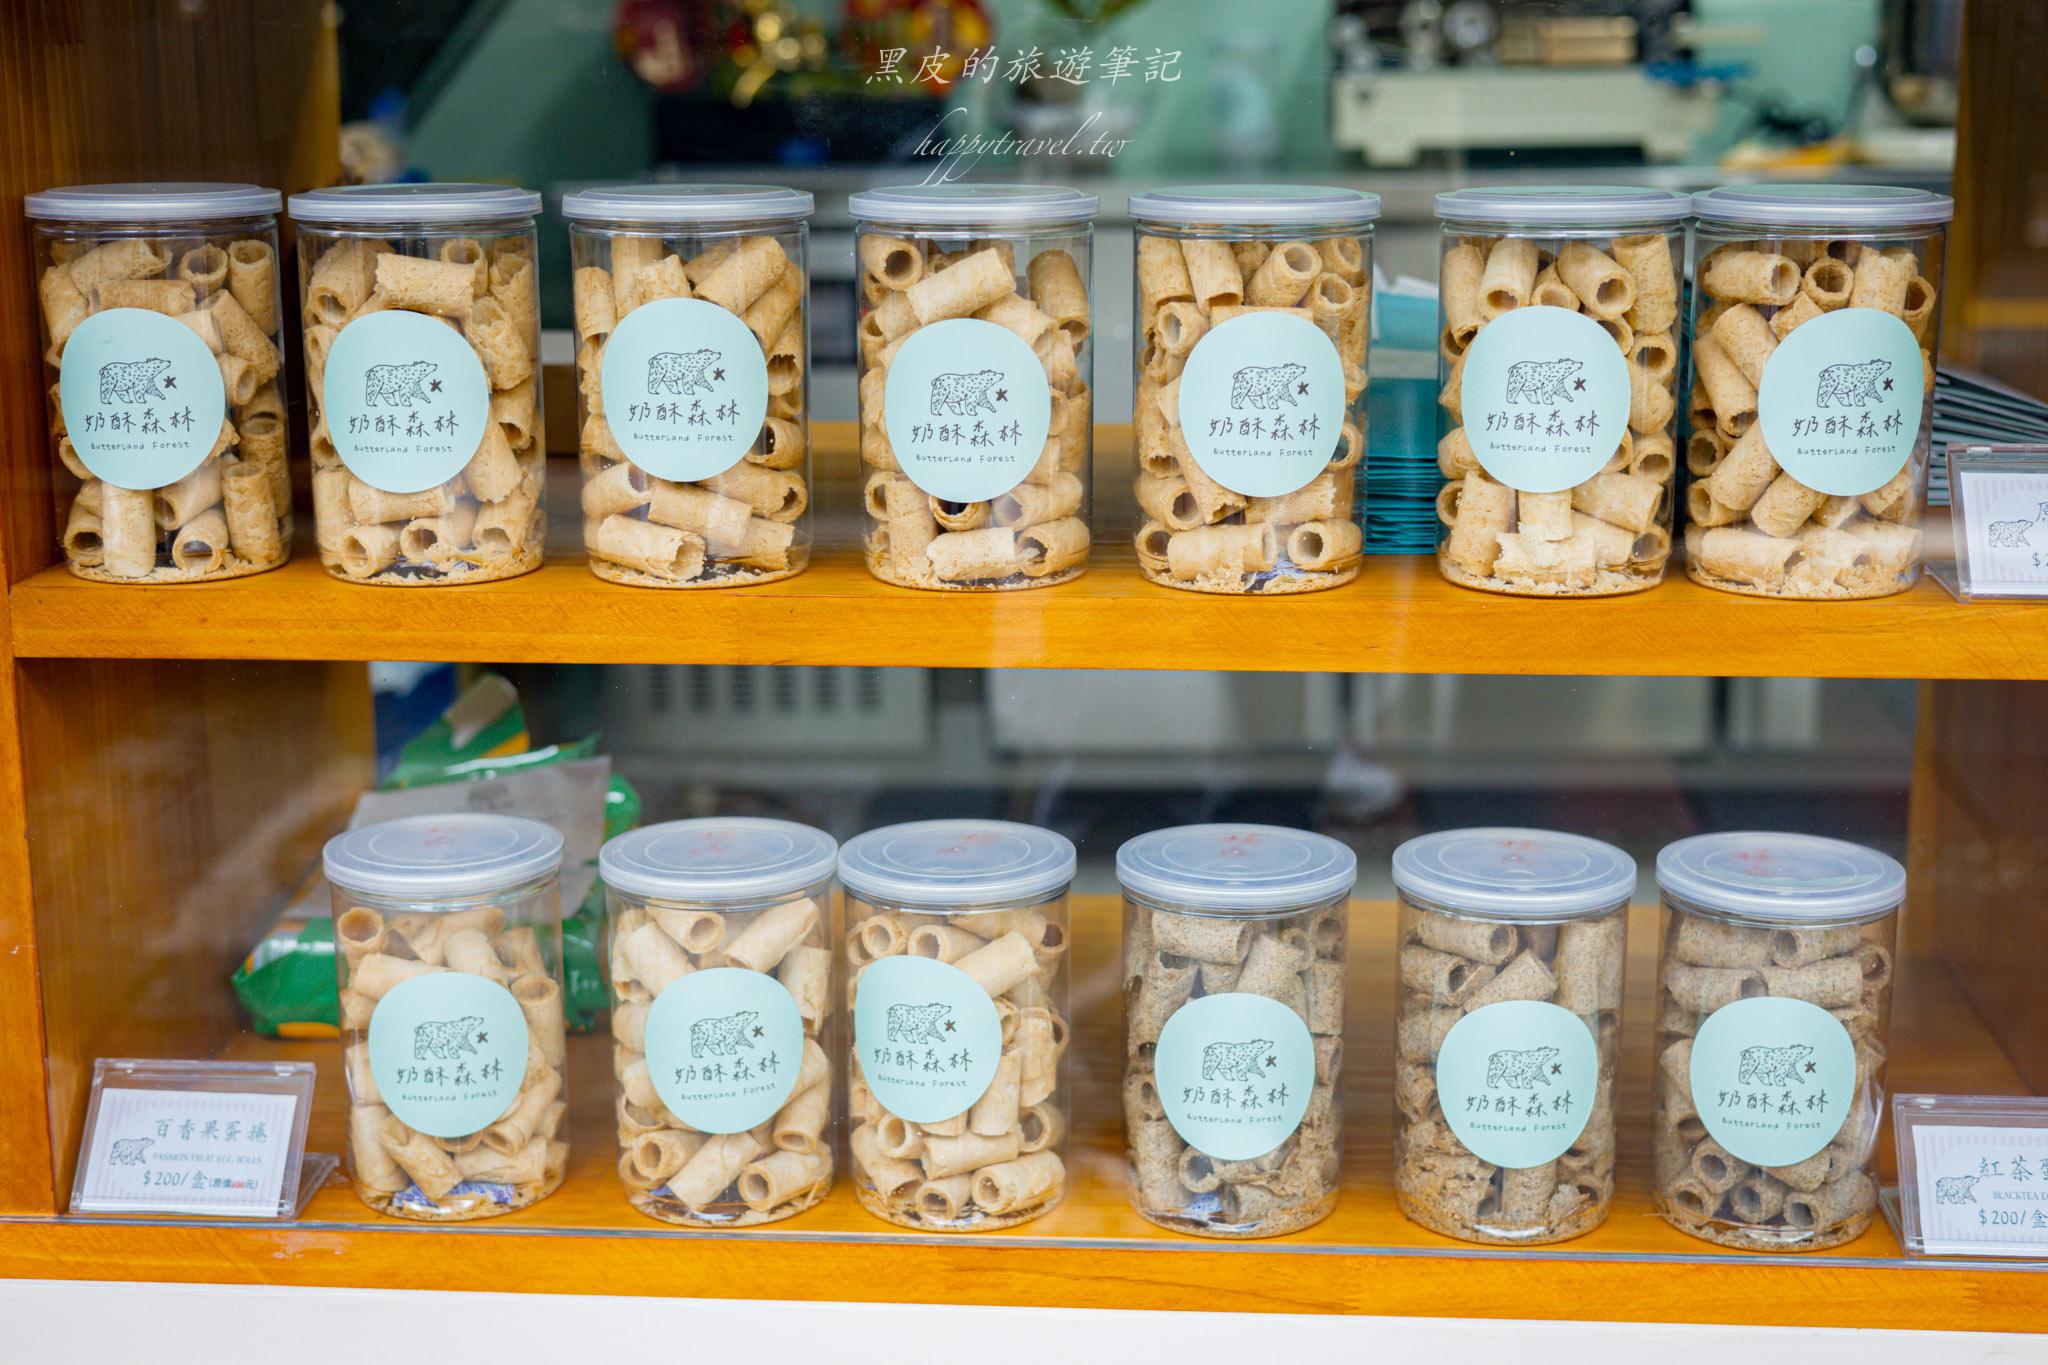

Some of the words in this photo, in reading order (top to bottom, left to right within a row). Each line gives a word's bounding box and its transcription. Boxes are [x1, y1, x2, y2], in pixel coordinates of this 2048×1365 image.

[85, 406, 195, 434] 奶酥森林
[349, 410, 459, 437] 奶酥森林
[629, 399, 740, 427] 奶酥森林
[1486, 409, 1600, 437] 奶酥森林
[1793, 409, 1903, 438] 奶酥森林
[634, 433, 689, 441] Butterland
[698, 434, 733, 442] Forest
[911, 419, 1023, 447] 奶酥森林
[1209, 413, 1320, 441] 奶酥森林
[91, 442, 144, 450] Butterland
[153, 440, 190, 450] Forest
[354, 445, 408, 453] Butterland
[416, 445, 453, 453] Forest
[1213, 448, 1271, 456] Butterland
[1280, 449, 1313, 457] Forest
[1490, 442, 1546, 452] Butterland
[1555, 445, 1591, 454] Forest
[1865, 445, 1896, 454] Forest
[916, 454, 971, 463] Butterland
[980, 455, 1015, 463] Forest
[397, 1059, 504, 1086] 奶酥森林
[675, 1051, 780, 1084] 奶酥森林
[874, 1048, 973, 1073] 奶酥森林
[1183, 1082, 1290, 1109] 奶酥森林
[1466, 1092, 1573, 1118] 奶酥森林
[1718, 1090, 1829, 1115] 奶酥森林
[156, 1118, 267, 1143] 百香果蛋捲
